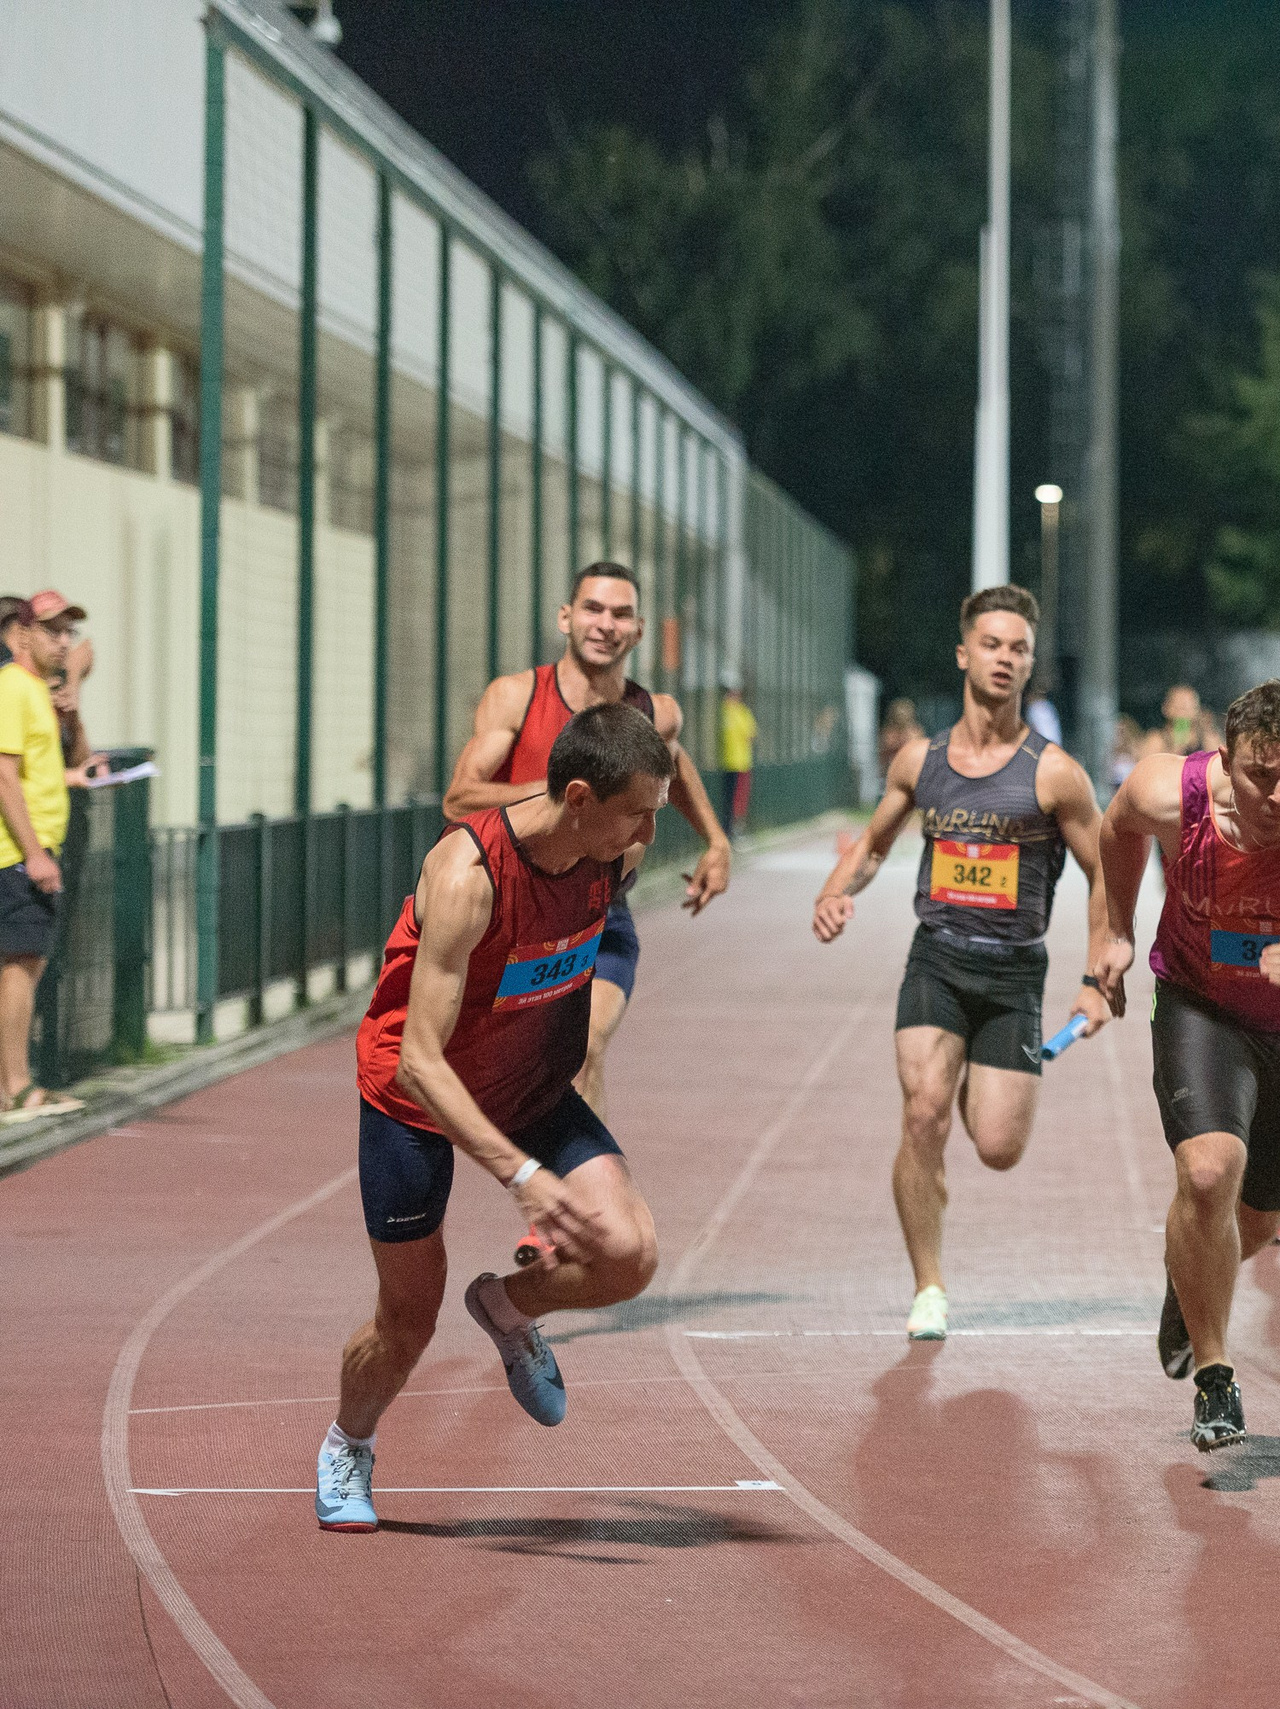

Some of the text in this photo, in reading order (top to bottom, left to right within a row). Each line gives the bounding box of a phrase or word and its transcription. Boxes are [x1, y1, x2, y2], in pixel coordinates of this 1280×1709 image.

[953, 863, 992, 887] 342
[531, 953, 590, 986] 343 3
